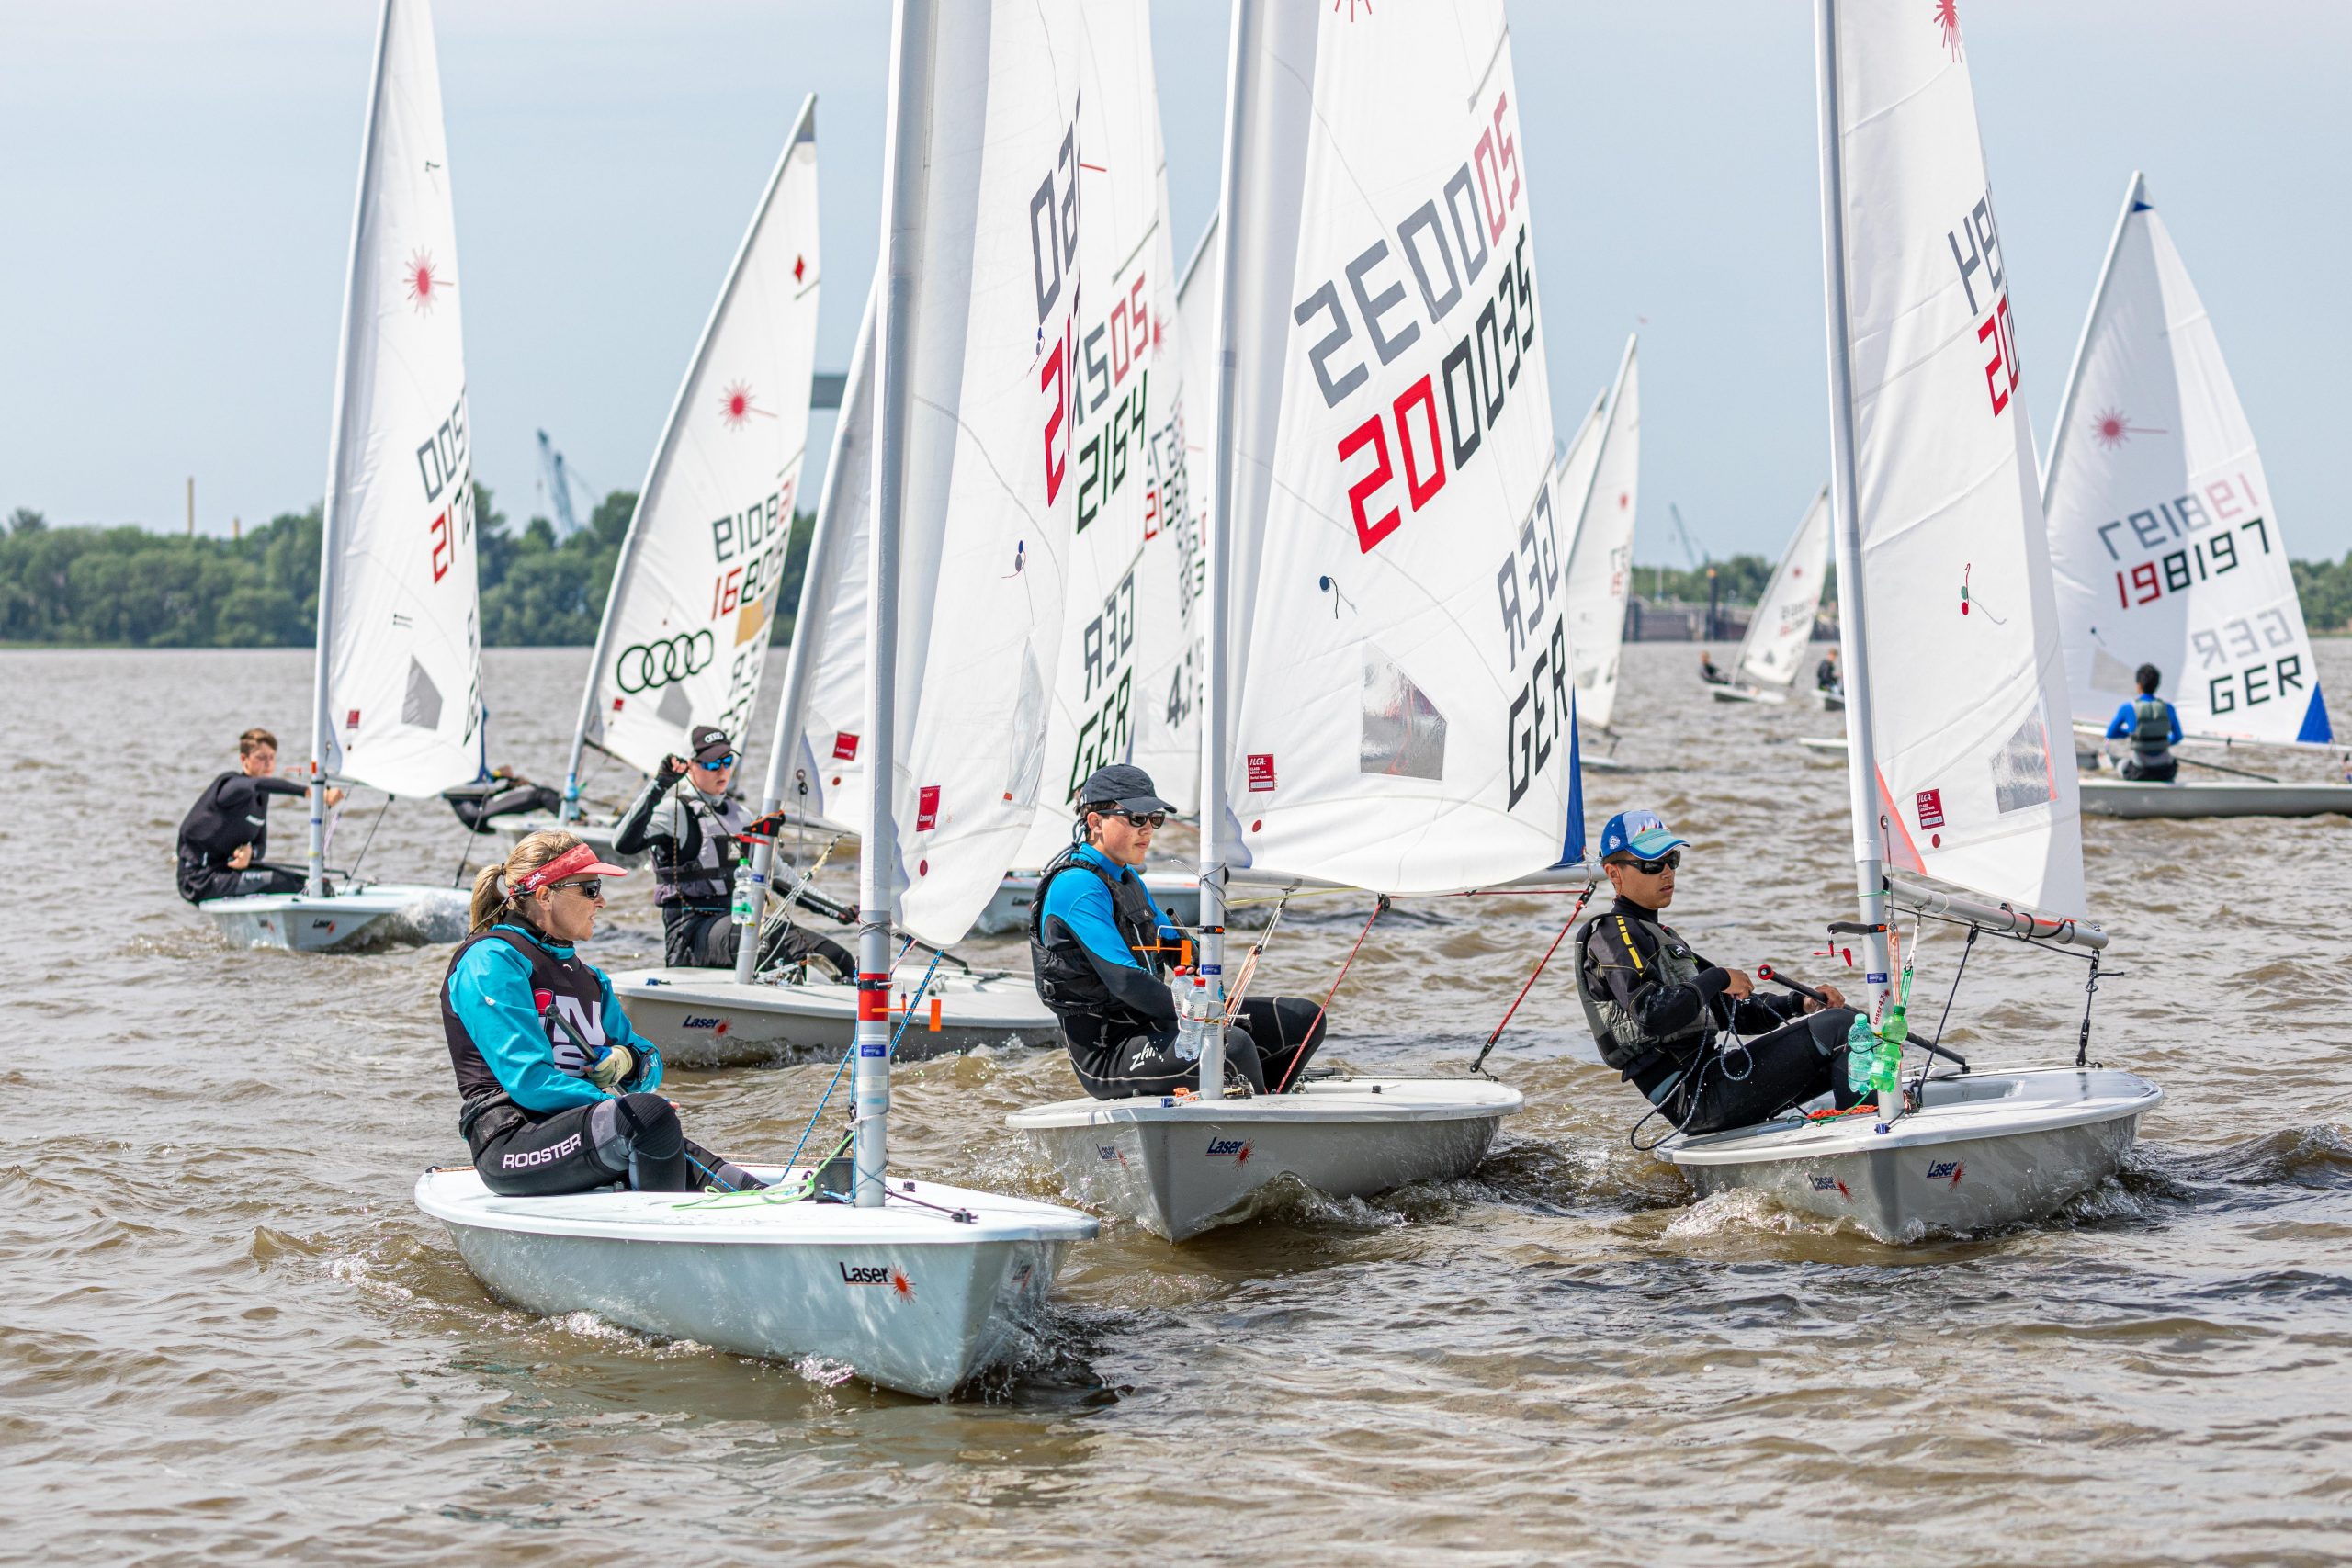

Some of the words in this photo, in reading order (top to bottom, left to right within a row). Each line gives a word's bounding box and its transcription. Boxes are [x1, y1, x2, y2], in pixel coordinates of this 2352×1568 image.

[1338, 222, 1535, 554] 200035
[1977, 292, 2019, 417] 20
[1042, 299, 1077, 508] 21
[1077, 369, 1148, 534] 2164
[2116, 516, 2271, 610] 198197
[1507, 612, 1568, 813] GER
[2209, 654, 2304, 716] GER
[1066, 664, 1132, 806] GER
[682, 1014, 721, 1029] Laser
[502, 1132, 582, 1168] ROOSTER
[1207, 1136, 1244, 1154] Laser
[1927, 1159, 1958, 1179] Laser
[840, 1261, 888, 1283] Laser
